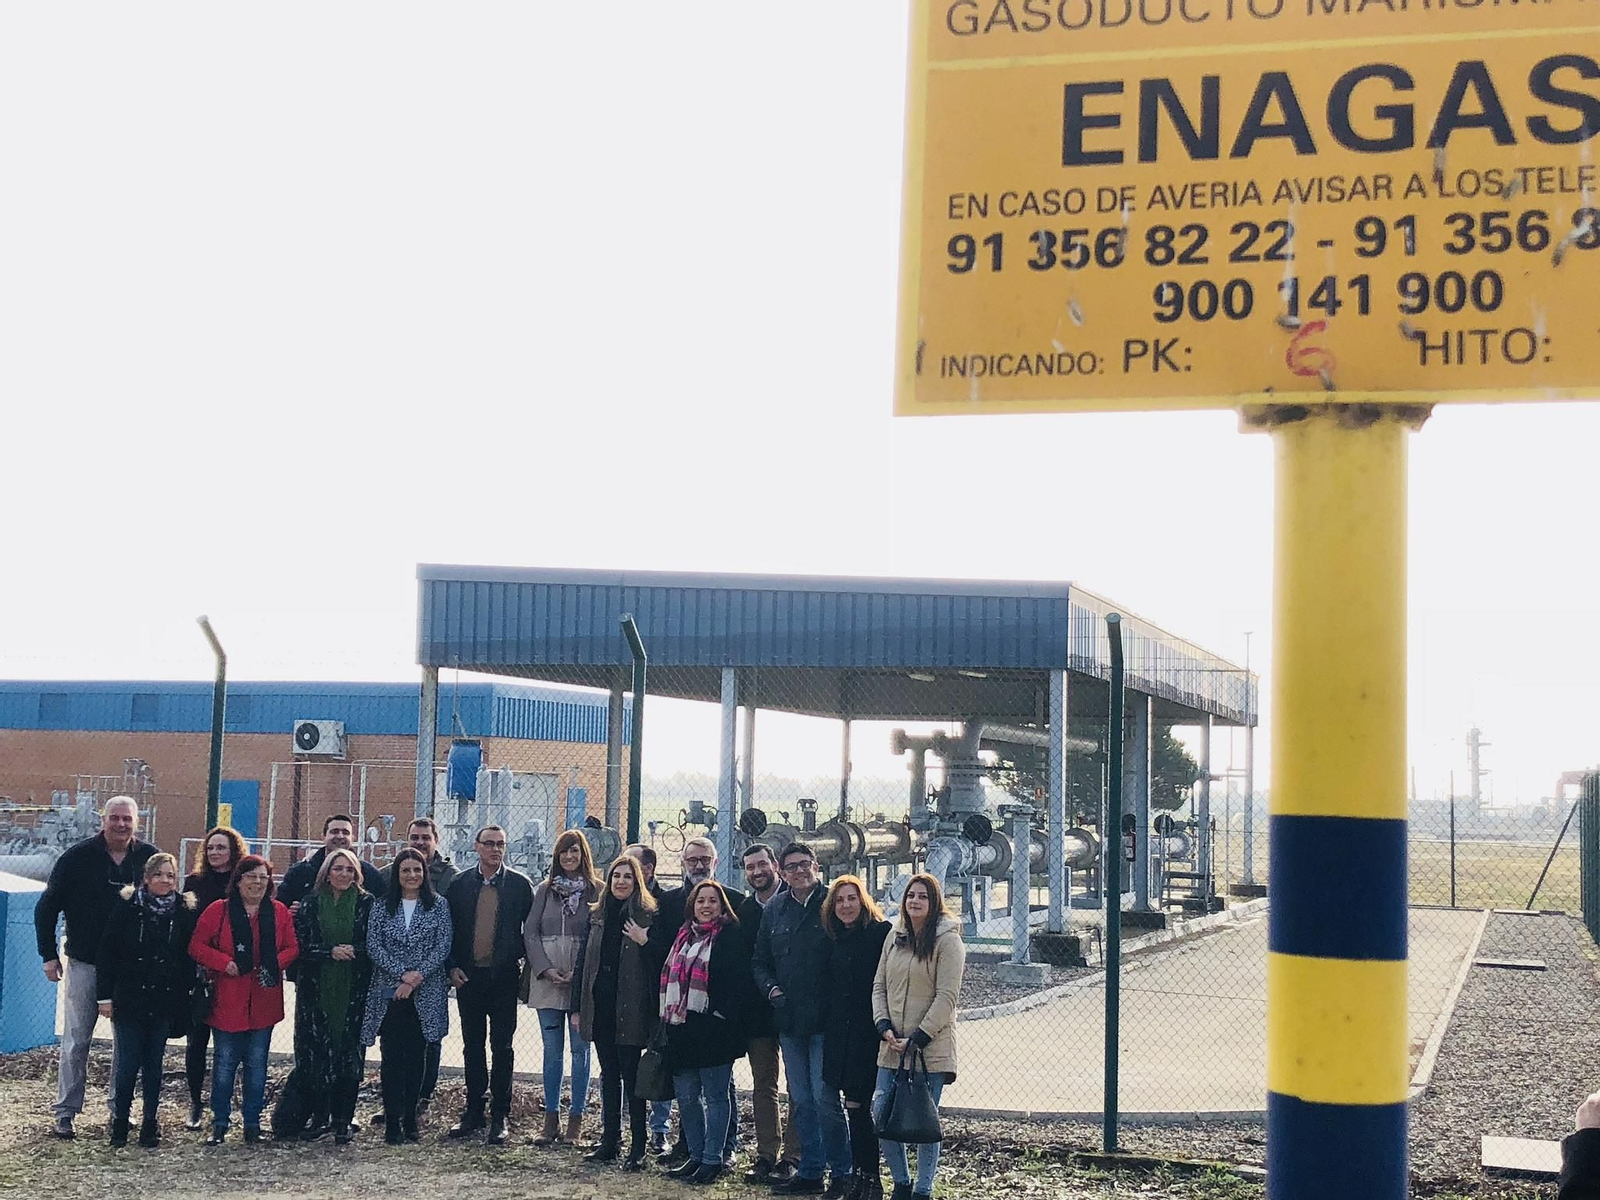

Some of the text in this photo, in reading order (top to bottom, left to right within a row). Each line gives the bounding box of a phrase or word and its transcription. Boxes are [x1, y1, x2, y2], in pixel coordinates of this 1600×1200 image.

[1061, 54, 1600, 167] ENAGAS
[948, 165, 1598, 220] EN CASO DE AVERIA AVISAR A LOS TELE
[947, 232, 1003, 275] 91
[1027, 226, 1127, 272] 356
[1144, 222, 1209, 267] 82
[1228, 217, 1296, 264] 22
[1317, 239, 1333, 248] -
[1355, 214, 1416, 258] 91
[1443, 208, 1550, 255] 356
[1153, 269, 1503, 323] 900 141 900
[940, 337, 1193, 378] INDICANDO: PK:
[1418, 327, 1552, 366] HITO:
